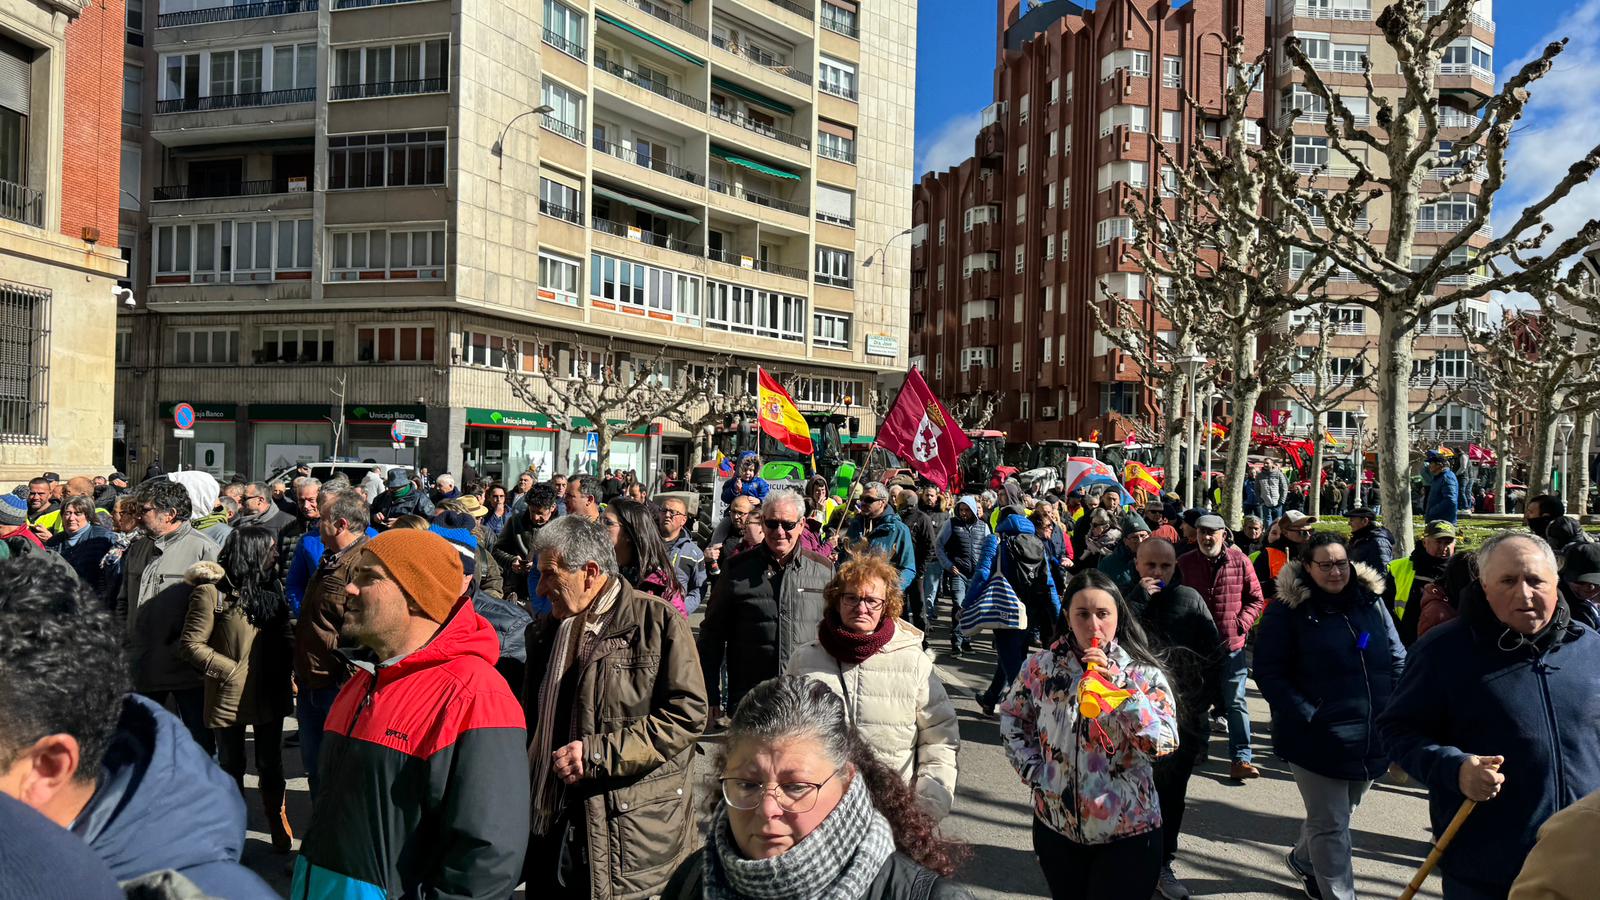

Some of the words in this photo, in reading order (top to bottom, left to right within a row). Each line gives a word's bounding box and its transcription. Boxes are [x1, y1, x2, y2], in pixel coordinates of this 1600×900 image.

[205, 410, 224, 418] Banco
[369, 411, 394, 420] Unicaja
[394, 411, 415, 419] Banco
[503, 416, 522, 426] Unicaja
[522, 417, 537, 426] Banco
